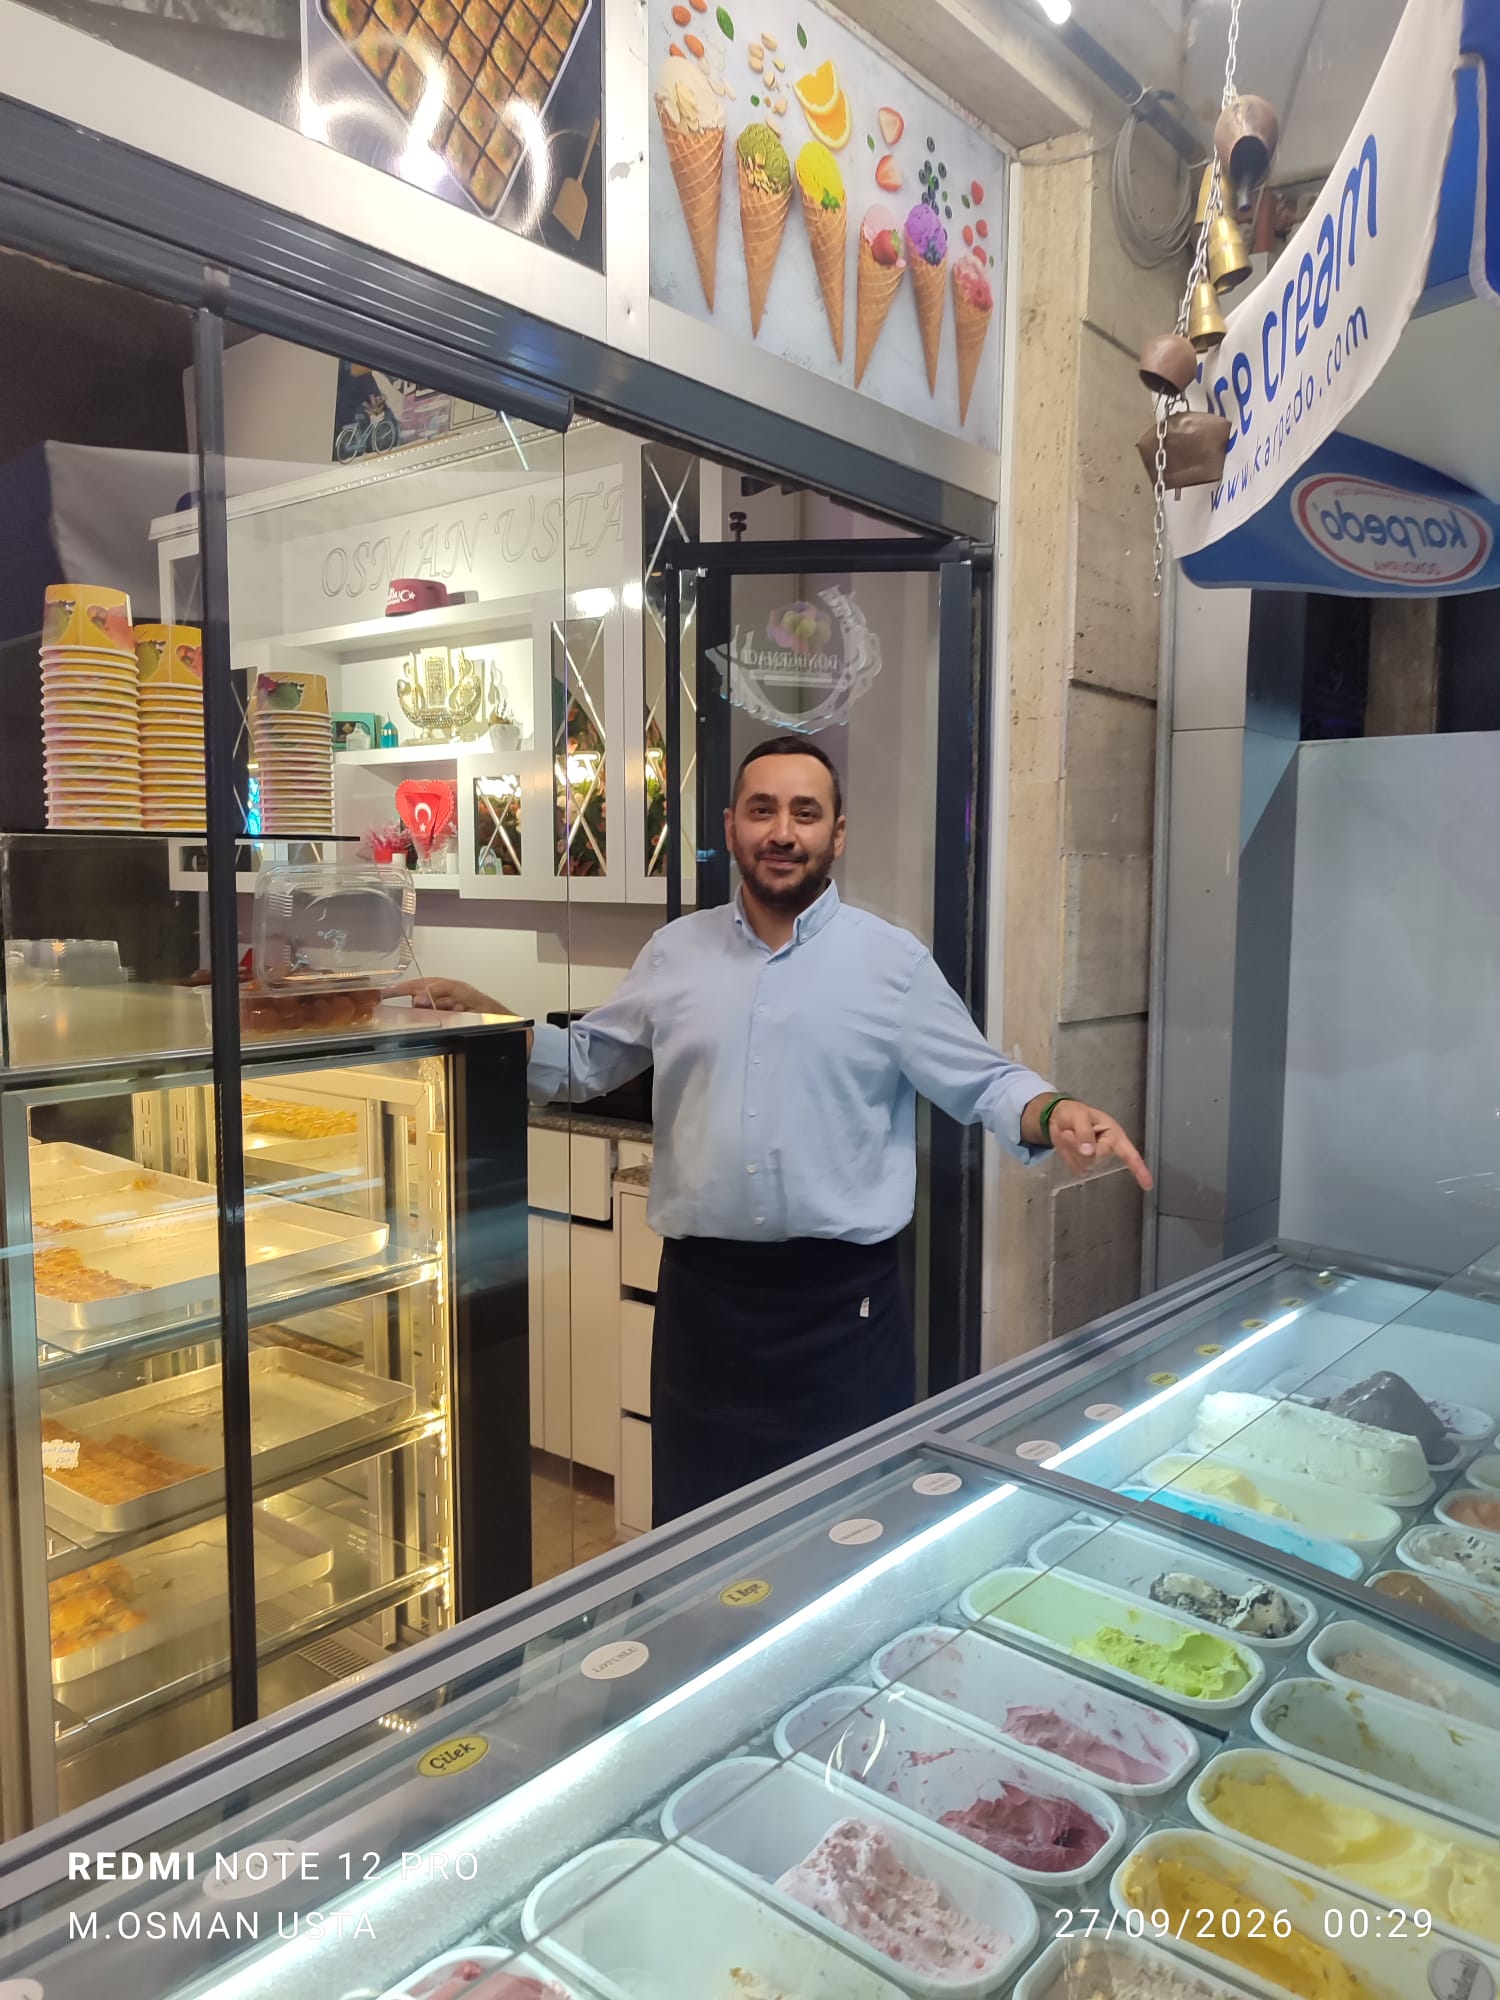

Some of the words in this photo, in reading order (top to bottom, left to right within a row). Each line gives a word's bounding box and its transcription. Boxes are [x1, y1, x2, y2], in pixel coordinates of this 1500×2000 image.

[1262, 133, 1378, 402] cream
[1210, 305, 1368, 513] www.karpedo.com
[322, 513, 489, 598] OSMAN
[494, 481, 624, 563] USTA
[429, 1743, 476, 1770] Çilek
